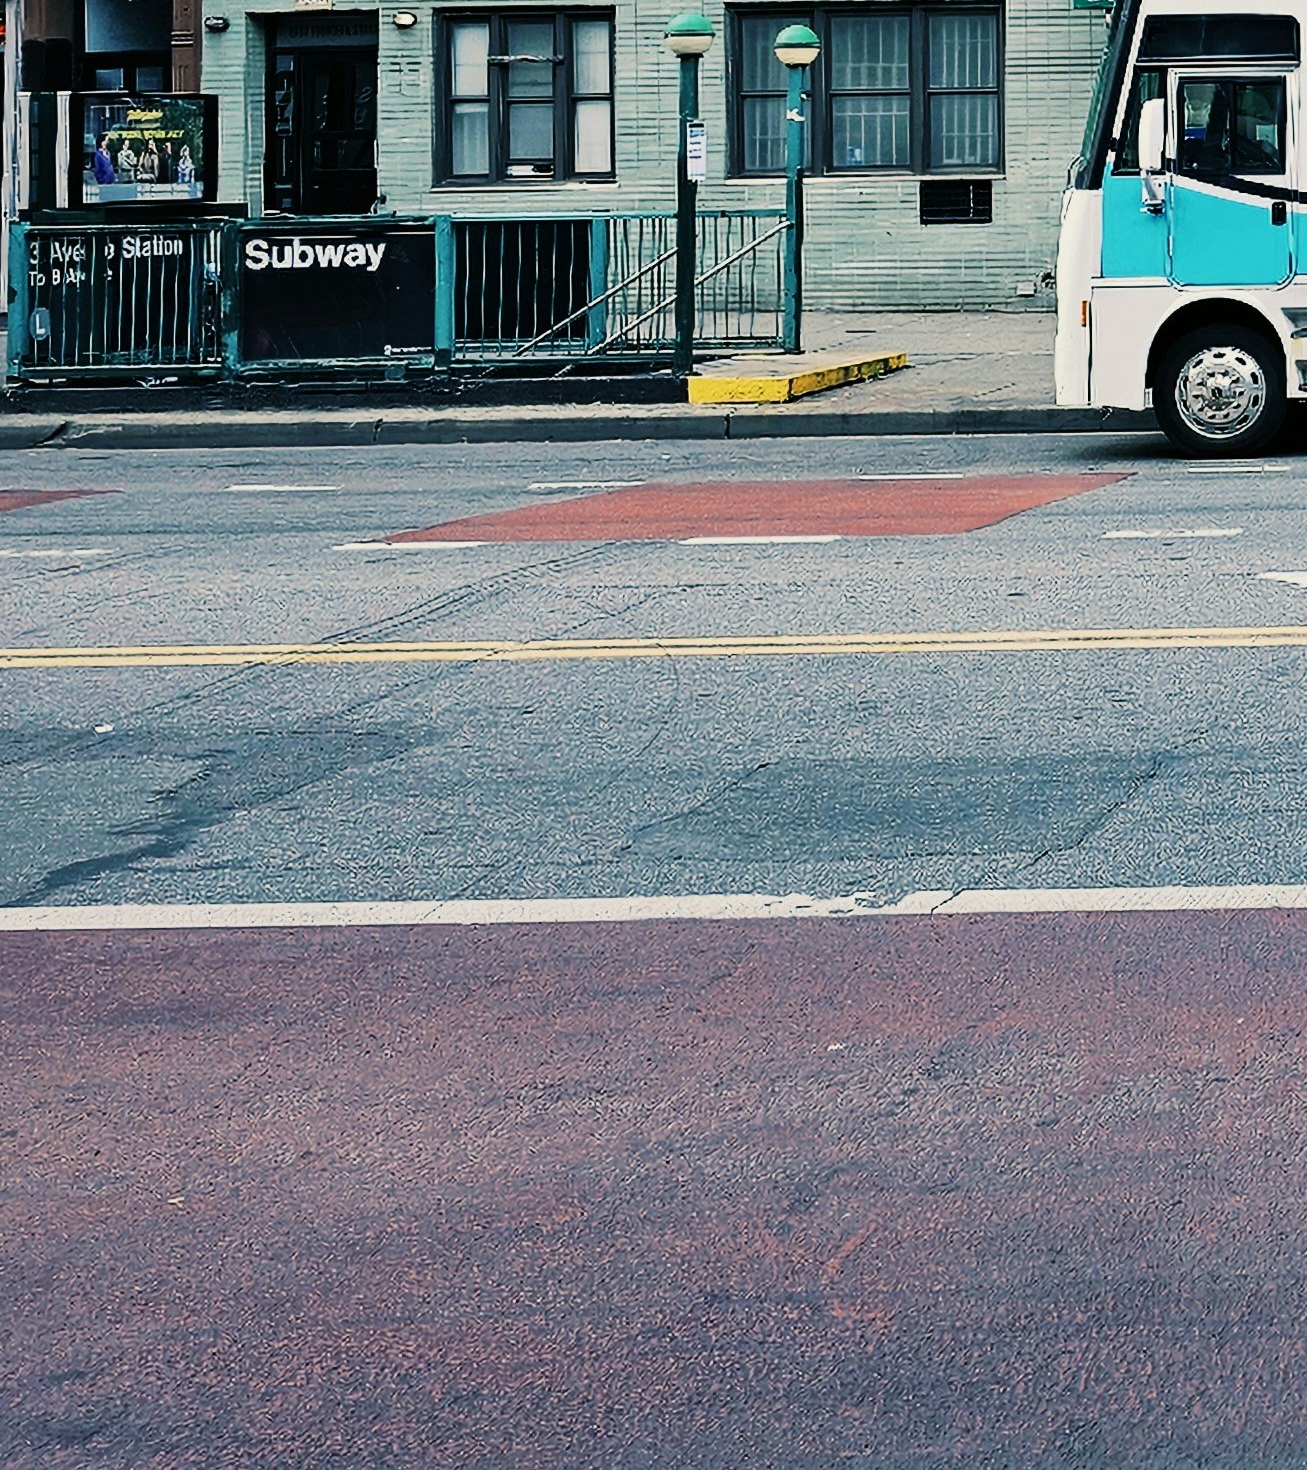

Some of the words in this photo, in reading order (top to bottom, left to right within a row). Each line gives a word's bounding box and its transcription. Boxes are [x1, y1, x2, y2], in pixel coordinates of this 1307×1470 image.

[29, 241, 40, 264] 3
[121, 235, 183, 259] Station
[244, 238, 387, 272] Subway
[35, 314, 46, 335] L
